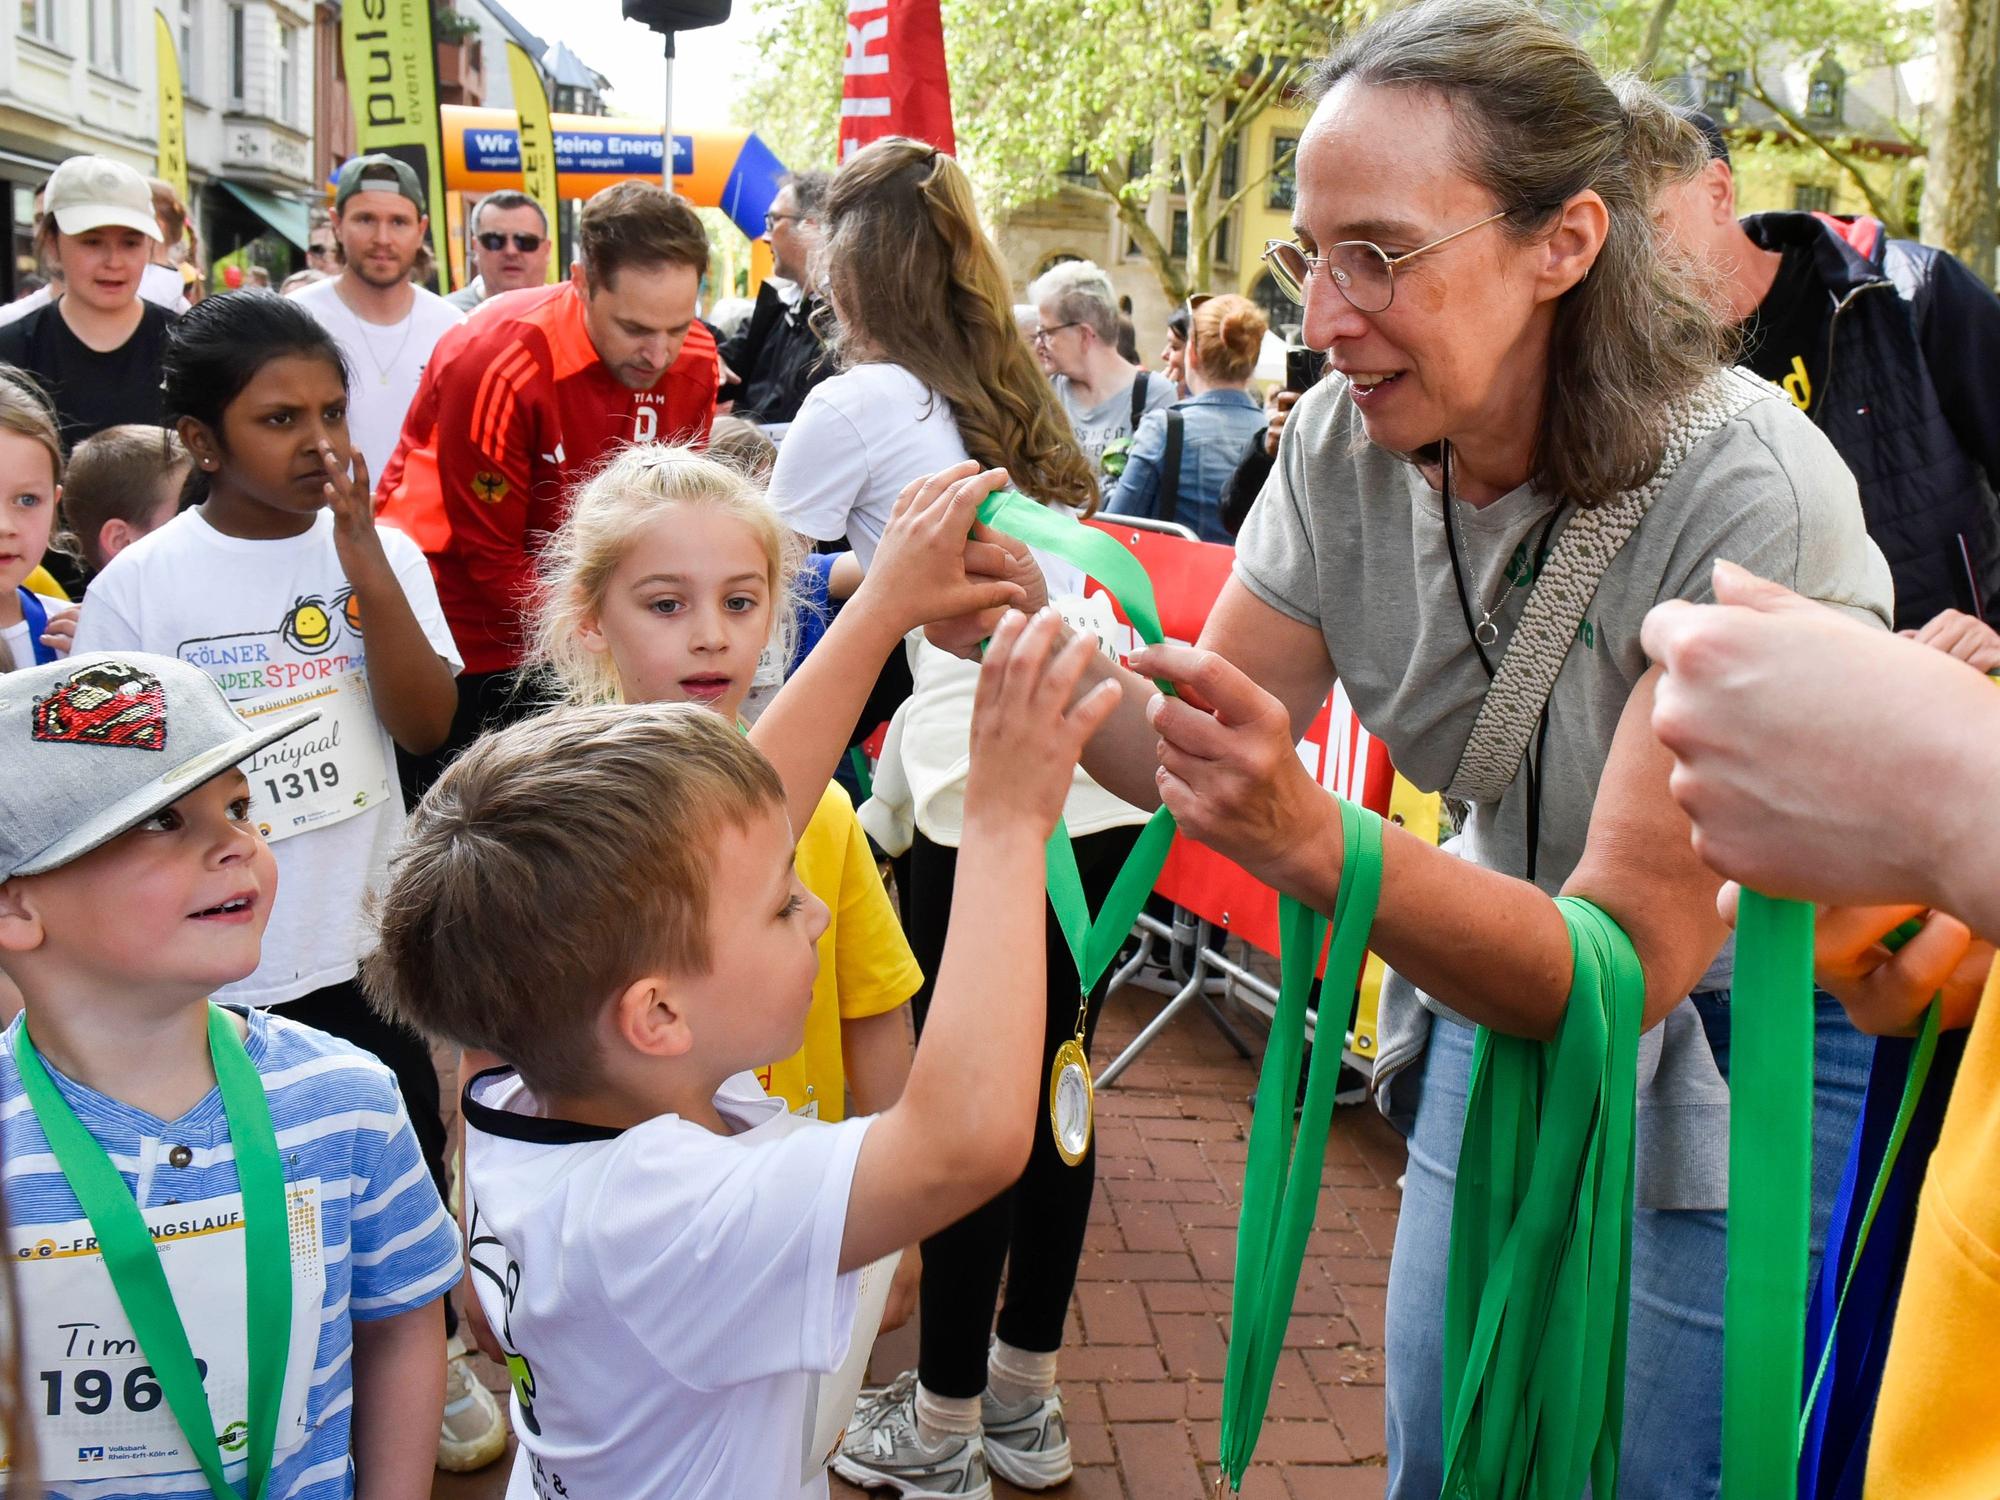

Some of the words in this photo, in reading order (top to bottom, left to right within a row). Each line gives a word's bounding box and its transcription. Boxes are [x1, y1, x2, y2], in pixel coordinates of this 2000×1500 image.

[403, 52, 422, 125] event
[476, 134, 512, 153] Wir
[607, 137, 686, 158] Energe.
[633, 406, 658, 442] D
[186, 643, 270, 668] KÖLNER
[248, 720, 342, 773] Iniyaal
[264, 761, 339, 804] 1319
[58, 1323, 137, 1358] Tim
[108, 1444, 147, 1452] Volksbank
[108, 1451, 166, 1460] Rhein-Erft-Köln
[872, 1427, 894, 1457] N
